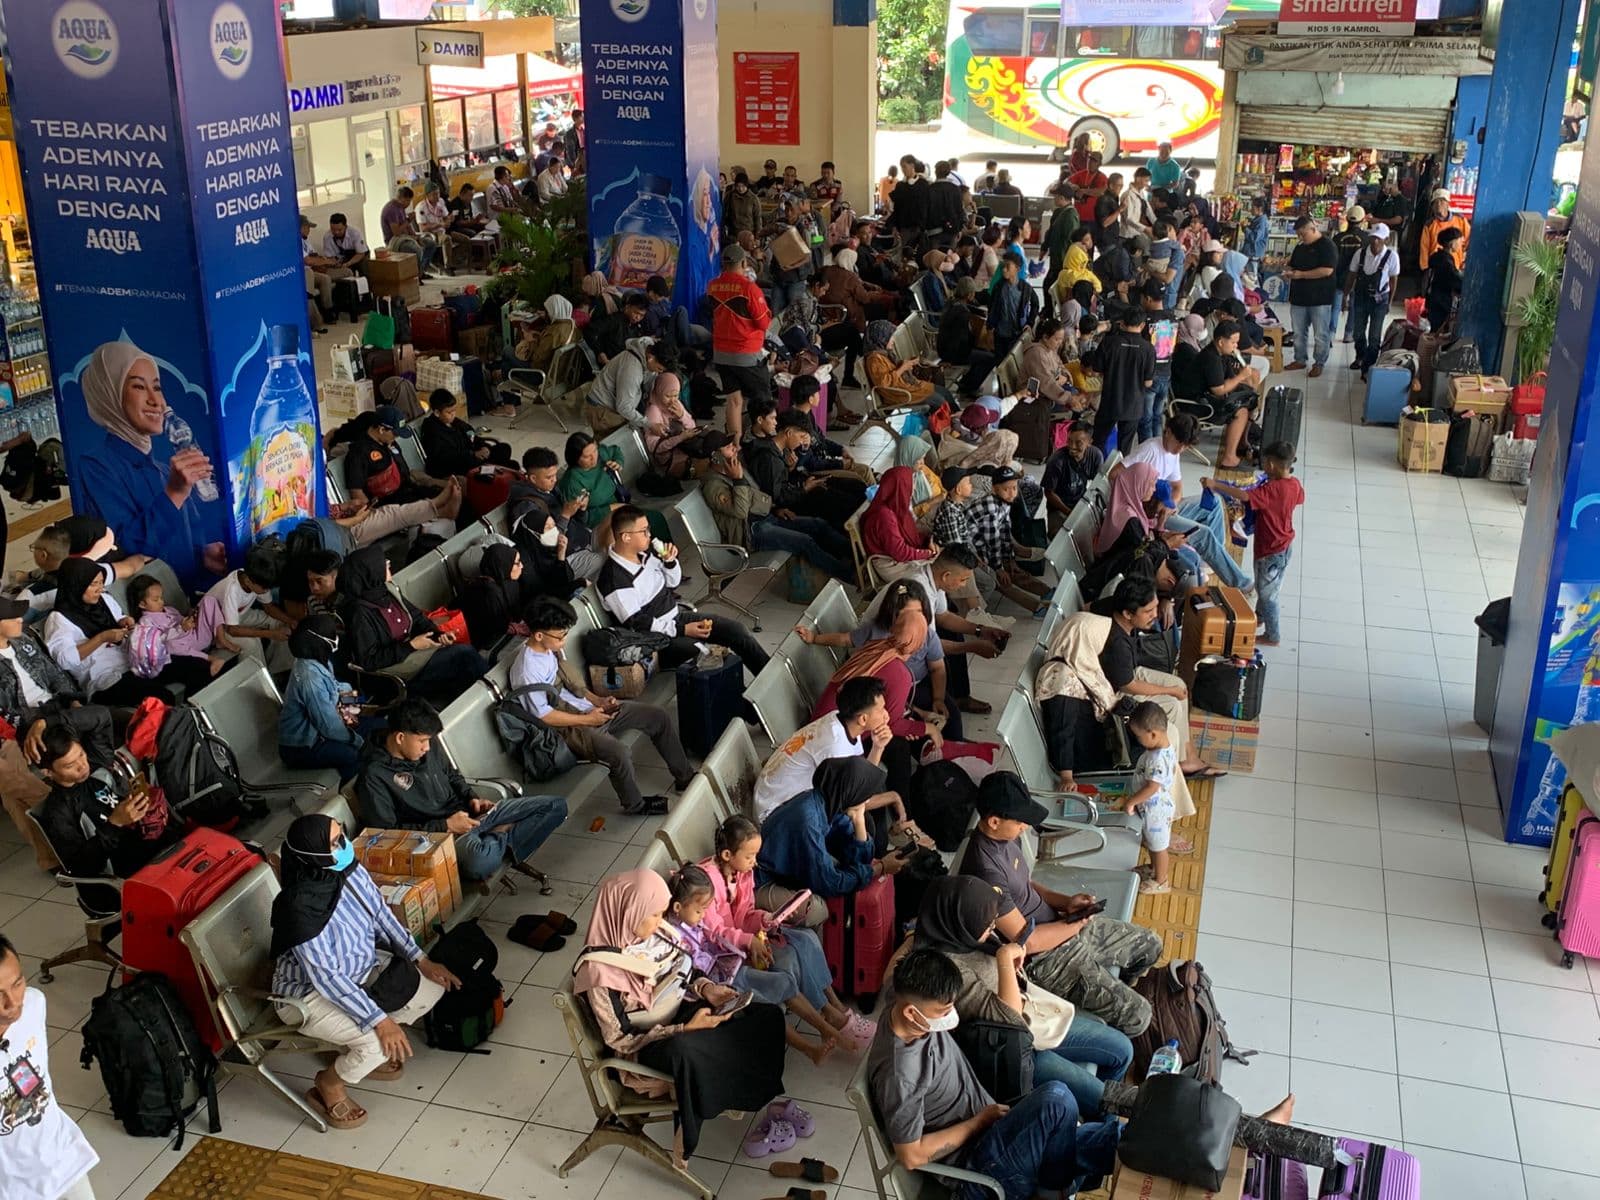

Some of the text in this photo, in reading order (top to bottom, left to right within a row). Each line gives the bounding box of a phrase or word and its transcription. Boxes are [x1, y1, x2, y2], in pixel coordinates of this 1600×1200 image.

[59, 17, 111, 43] AQUA
[214, 20, 248, 45] AQUA
[1307, 25, 1381, 33] KIOS 19 KAMROL
[434, 41, 479, 57] DAMRI
[591, 44, 673, 56] TEBARKAN
[1269, 41, 1311, 50] PASTIKAN
[1312, 41, 1334, 49] FISIK
[1335, 41, 1361, 49] ANDA
[1363, 41, 1391, 49] SEHAT
[1413, 41, 1444, 49] PRIMA
[595, 59, 670, 71] ADEMNYA
[595, 75, 670, 87] HARI RAYA
[291, 84, 344, 112] DAMRI
[602, 90, 664, 101] DENGAN
[616, 106, 651, 121] AQUA
[31, 119, 167, 143] TEBARKAN
[196, 112, 282, 142] TEBARKAN
[42, 147, 164, 169] ADEMNYA
[204, 137, 280, 168] ADEMNYA
[44, 173, 168, 196] HARI RAYA
[205, 164, 283, 194] HARI RAYA
[57, 199, 161, 222] DENGAN
[215, 188, 280, 219] DENGAN
[86, 228, 142, 254] AQUA
[235, 218, 270, 246] AQUA
[55, 283, 186, 301] #TEMANADEMRAMADAN
[215, 265, 296, 300] #TEMANADEMRAMADAN
